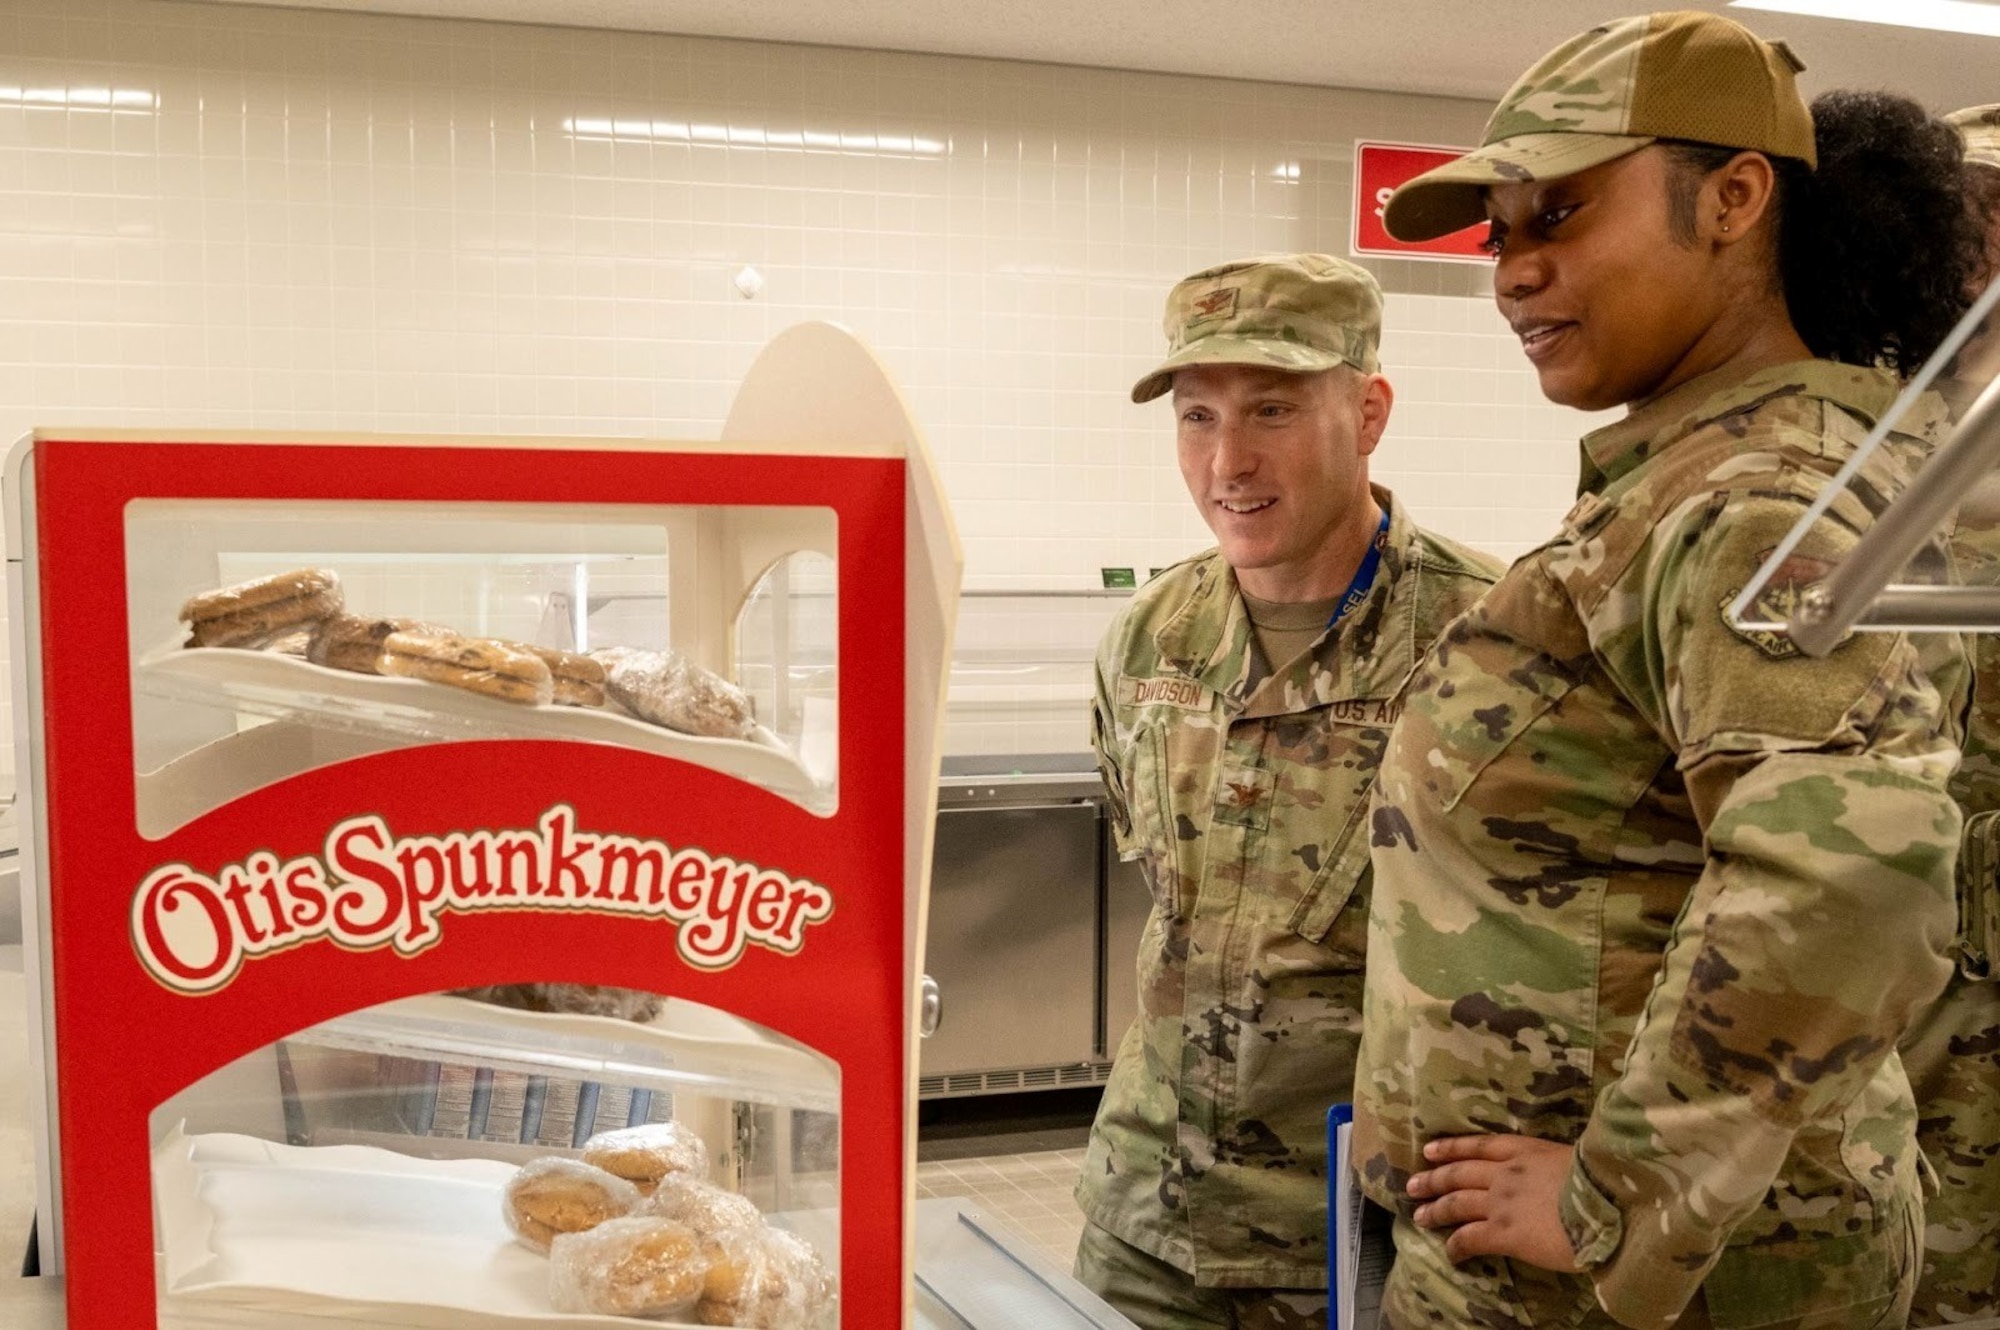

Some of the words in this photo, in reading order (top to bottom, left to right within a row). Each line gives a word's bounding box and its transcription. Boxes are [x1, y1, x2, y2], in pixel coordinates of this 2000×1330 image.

[1135, 680, 1203, 706] DAVIDSON
[1335, 699, 1367, 722] U.S.
[139, 860, 329, 981] Otis
[331, 812, 825, 959] Spunkmeyer
